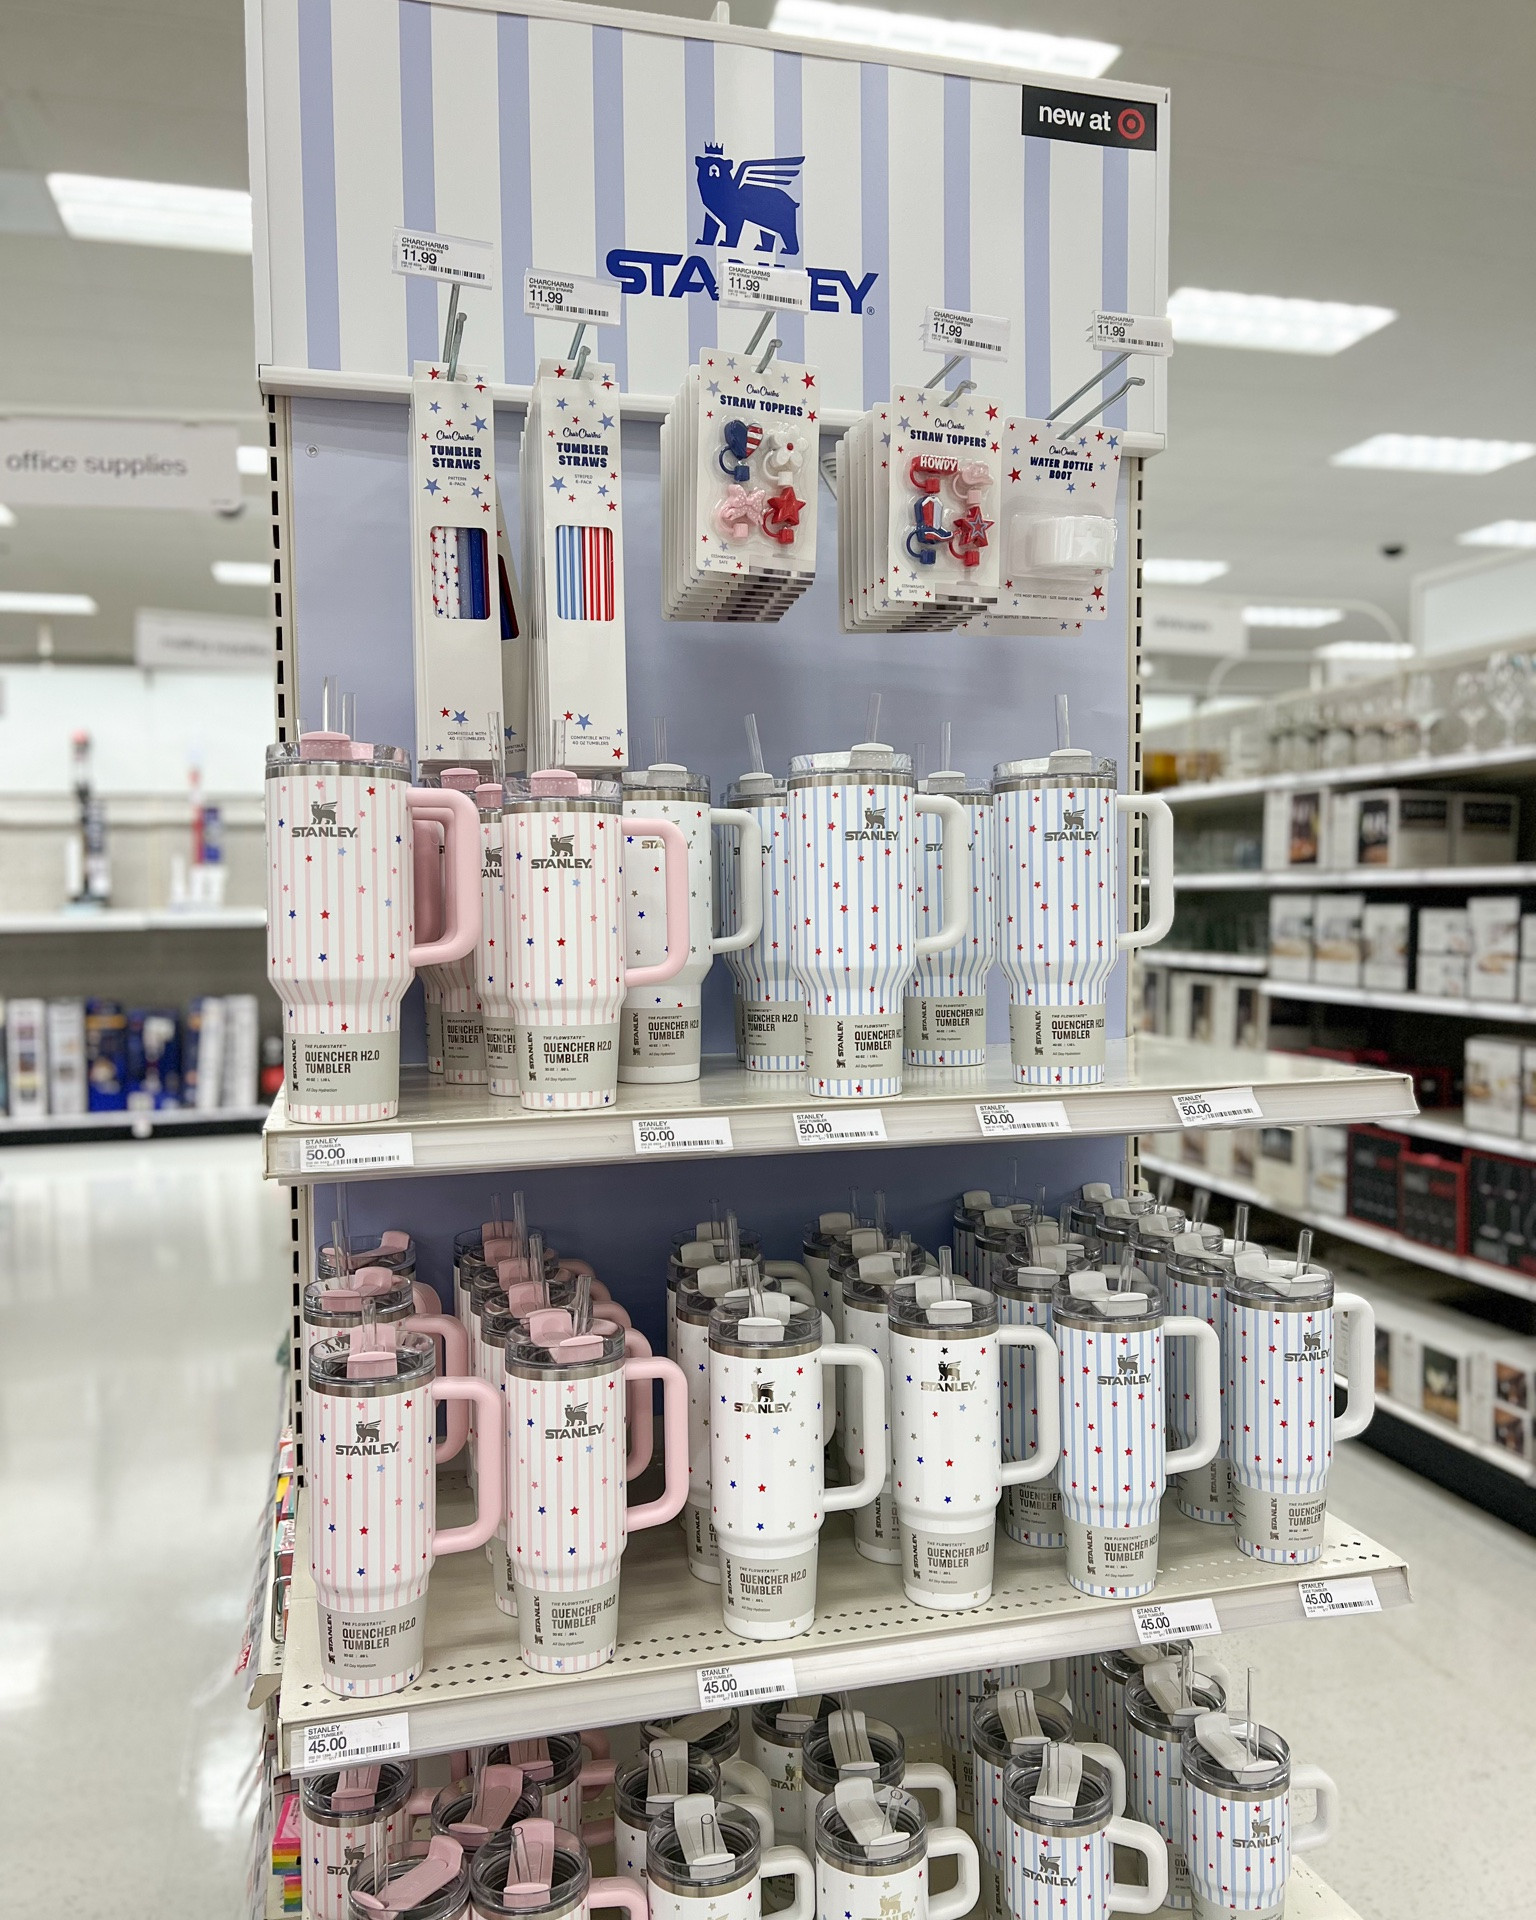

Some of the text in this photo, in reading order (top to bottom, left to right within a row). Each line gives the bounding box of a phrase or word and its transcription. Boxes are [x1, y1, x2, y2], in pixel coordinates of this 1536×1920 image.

[1039, 105, 1111, 131] new at
[402, 237, 448, 250] CHARCHARMS
[402, 249, 436, 264] 11.99
[729, 267, 770, 277] CHARCHARMS
[529, 278, 574, 289] CHARCHARMS
[730, 277, 760, 291] 11.99
[530, 289, 563, 304] 11.99
[934, 311, 973, 323] CHARCHARMS
[1097, 315, 1134, 324] CHARCHARMS
[934, 322, 962, 337] 11.99
[1098, 324, 1125, 337] 11.99
[720, 394, 802, 416] STRAW TOPPERS
[910, 430, 986, 448] STRAW TOPPERS
[430, 445, 482, 457] TUMBLER
[556, 442, 608, 455] TUMBLER
[6, 451, 188, 478] office supplies
[432, 457, 480, 470] STRAWS
[559, 455, 607, 468] STRAWS
[920, 456, 958, 471] HOWDY
[1030, 456, 1093, 471] WATER BOTTLE
[1049, 470, 1072, 480] BOOT
[292, 826, 358, 838] STANLEY
[845, 830, 900, 842] STANLEY
[1044, 830, 1100, 842] STANLEY
[530, 858, 592, 870] STANLEY
[935, 1009, 974, 1019] QUENCHER
[648, 1020, 689, 1031] QUENCHER
[935, 1018, 970, 1027] TUMBLER
[1052, 1020, 1095, 1030] QUENCHER
[648, 1031, 685, 1041] TUMBLER
[854, 1030, 896, 1041] QUENCHER
[1052, 1030, 1090, 1040] TUMBLER
[543, 1042, 595, 1053] QUENCHER
[854, 1041, 892, 1051] TUMBLER
[305, 1050, 380, 1062] QUENCHER H2.0
[544, 1053, 589, 1064] TUMBLER
[305, 1063, 351, 1074] TUMBLER
[1182, 1104, 1212, 1116] 50.00
[983, 1114, 1015, 1125] 50.00
[799, 1123, 832, 1134] 50.00
[640, 1130, 675, 1142] 50.00
[306, 1148, 345, 1161] 50.00
[1284, 1349, 1330, 1362] STANLEY
[1097, 1373, 1151, 1386] STANLEY
[920, 1381, 976, 1392] STANLEY
[734, 1402, 792, 1414] STANLEY
[545, 1422, 604, 1440] STANLEY
[335, 1442, 400, 1456] STANLEY
[1289, 1514, 1320, 1526] TUMBLER
[1104, 1539, 1148, 1552] QUENCHER
[927, 1547, 975, 1558] QUENCHER
[1104, 1551, 1144, 1562] TUMBLER
[928, 1557, 969, 1568] TUMBLER
[740, 1568, 807, 1585] QUENCHER H2.0
[740, 1583, 783, 1595] TUMBLER
[1305, 1592, 1333, 1605] 45.00
[533, 1596, 542, 1633] STANLEY
[551, 1603, 602, 1619] QUENCHER
[1137, 1606, 1161, 1615] STANLEY
[342, 1616, 416, 1640] QUENCHER H2.0
[551, 1615, 596, 1630] TUMBLER
[1141, 1616, 1170, 1630] 45.00
[342, 1637, 389, 1650] TUMBLER
[701, 1668, 730, 1677] STANLEY
[704, 1678, 737, 1694] 45.00
[308, 1725, 340, 1735] STANLEY
[308, 1736, 347, 1754] 45.00
[1232, 1835, 1282, 1849] STANLEY
[1022, 1868, 1077, 1887] STANLEY
